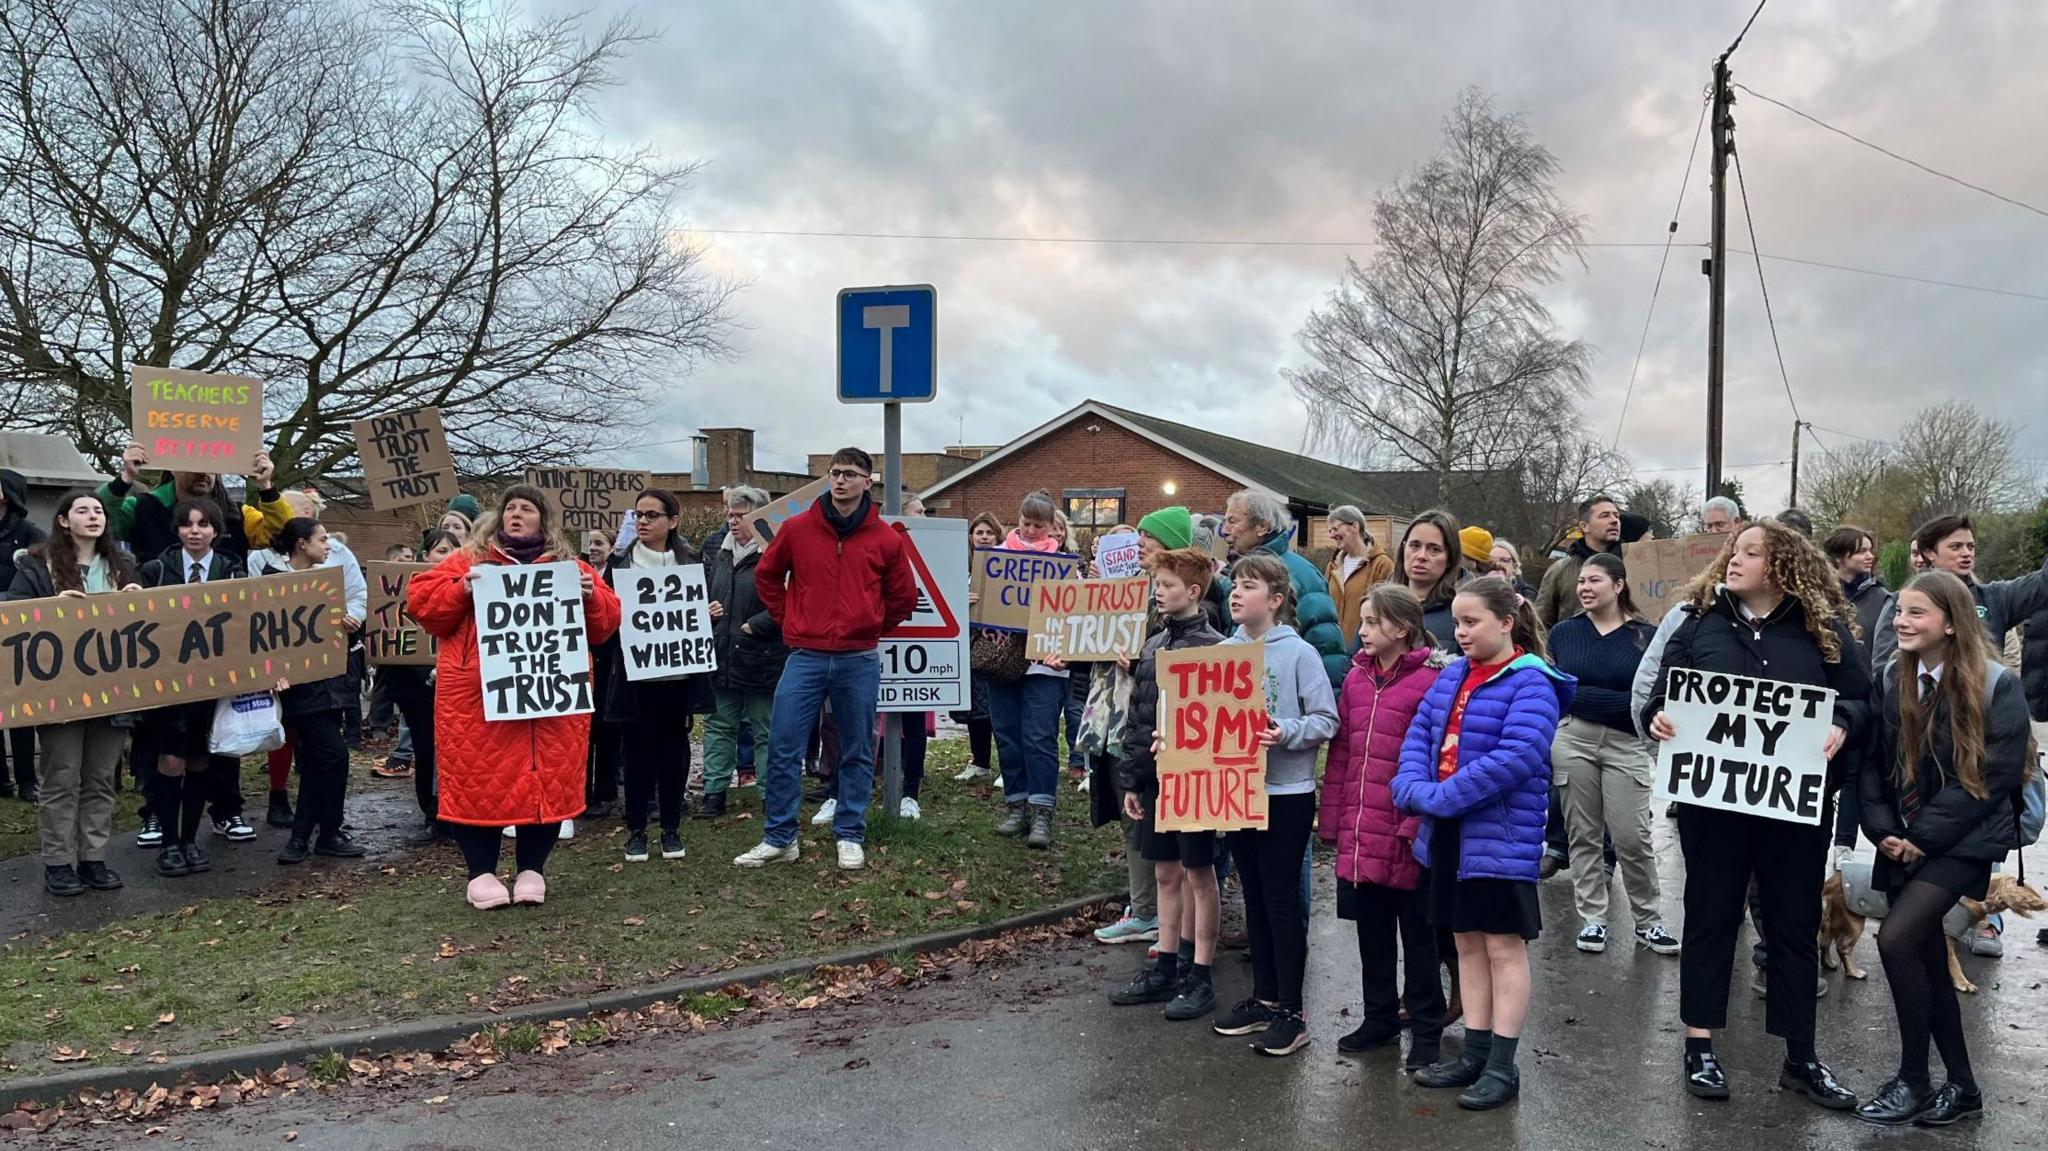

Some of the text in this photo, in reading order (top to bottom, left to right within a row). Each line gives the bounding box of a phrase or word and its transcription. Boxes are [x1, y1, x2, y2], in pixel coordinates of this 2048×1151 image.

[146, 379, 250, 405] TEACHERS
[147, 409, 239, 432] DESERVE
[367, 428, 430, 458] TRUST
[382, 471, 441, 499] TRUST
[579, 469, 645, 492] TEACHERS
[560, 488, 611, 510] CUTS
[1105, 548, 1136, 566] STAND
[501, 570, 554, 598] WE
[1039, 580, 1148, 614] NO TRUST
[487, 597, 581, 630] DON'T
[632, 608, 699, 633] GONE
[1045, 616, 1065, 634] IN
[1, 604, 326, 686] TO CUTS AT RHSC
[365, 627, 418, 657] THE
[481, 627, 584, 656] TRUST
[1033, 612, 1148, 656] THE TRUST
[509, 653, 562, 675] THE
[630, 637, 714, 669] WHERE?
[885, 644, 928, 674] 10
[929, 664, 954, 675] mph
[486, 671, 591, 714] TRUST
[902, 687, 941, 702] RISK
[1168, 660, 1254, 700] THIS
[1668, 669, 1827, 719] PROTECT
[1175, 701, 1266, 756] IS MY
[1705, 712, 1792, 756] MY
[1160, 767, 1265, 821] FUTURE
[1667, 752, 1824, 818] FUTURE
